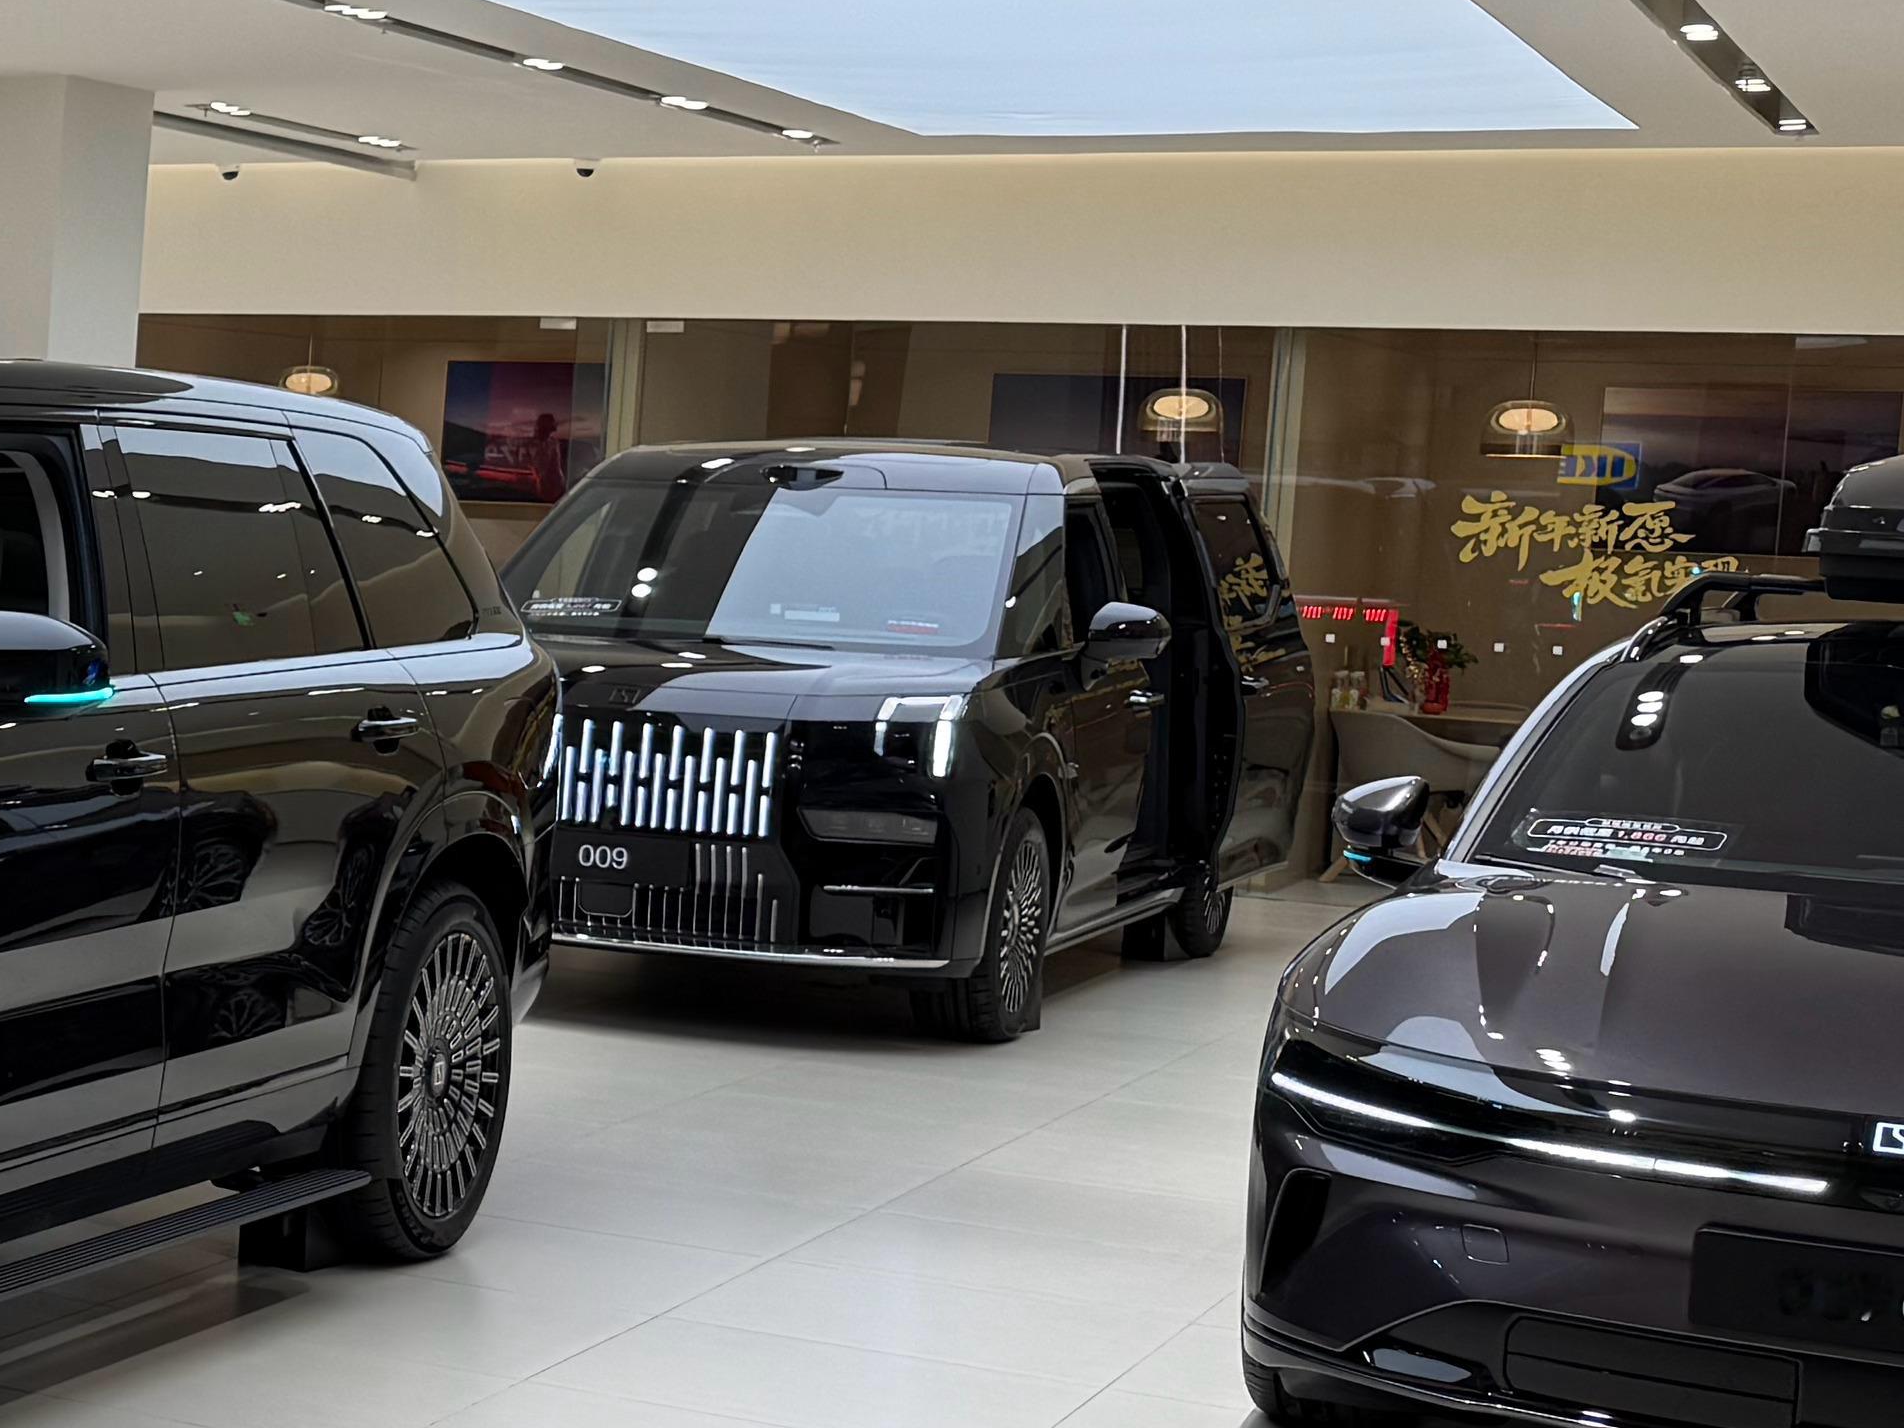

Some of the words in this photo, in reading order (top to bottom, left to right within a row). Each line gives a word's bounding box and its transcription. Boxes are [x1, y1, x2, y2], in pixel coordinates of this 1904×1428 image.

[1450, 490, 1697, 572] 新年新愿
[578, 843, 629, 870] 009
